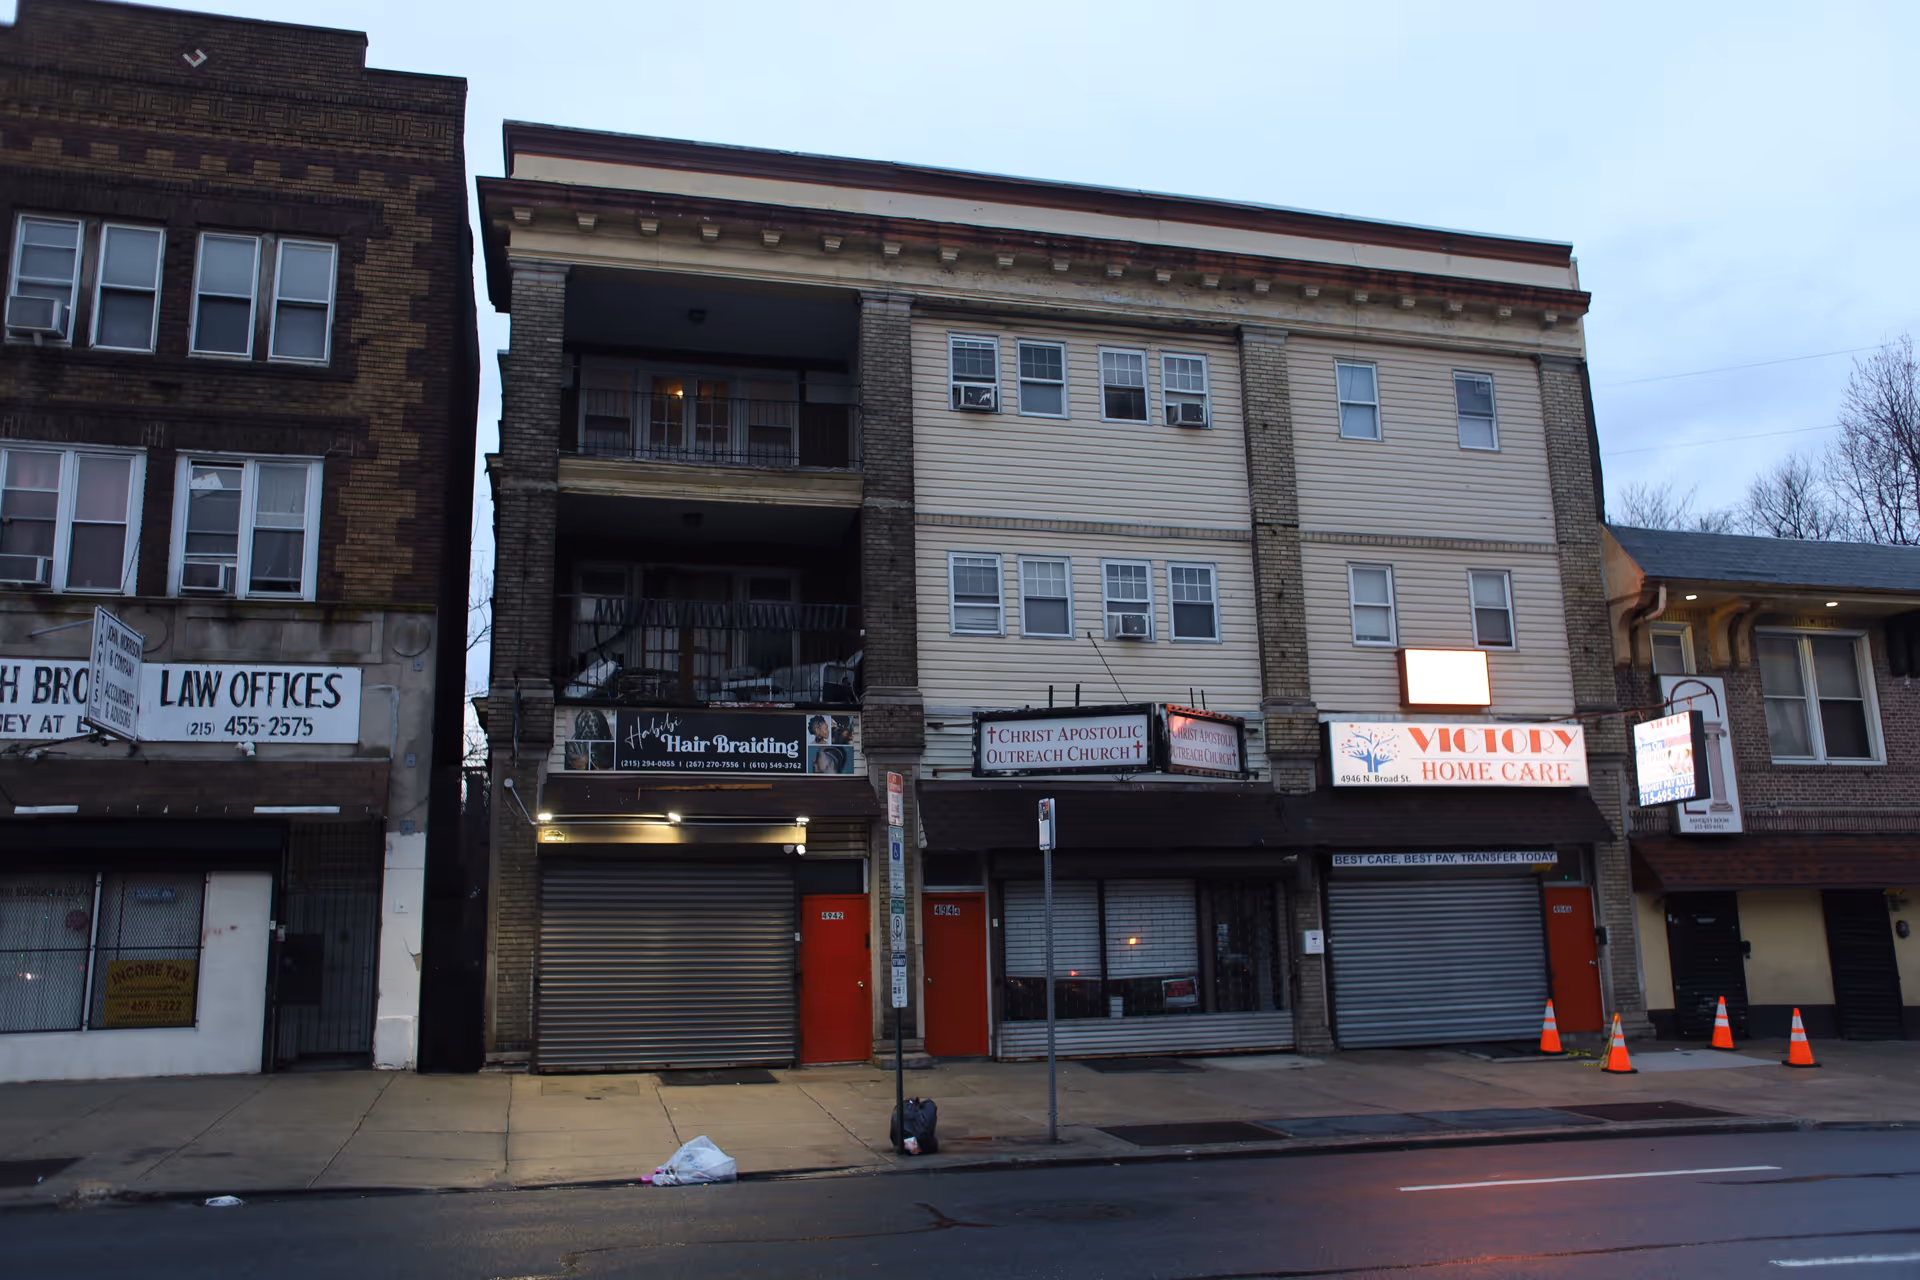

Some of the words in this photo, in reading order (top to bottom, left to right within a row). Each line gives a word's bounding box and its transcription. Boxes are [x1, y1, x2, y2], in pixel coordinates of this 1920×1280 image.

[94, 615, 106, 703] TAXES
[114, 653, 136, 679] COMPANY
[104, 680, 135, 711] ACCOUNTANTS
[160, 669, 223, 708] LAW
[229, 671, 343, 709] OFFICES
[39, 714, 66, 733] AT
[110, 703, 132, 730] ADVISORS
[186, 722, 216, 736] (215)
[224, 715, 314, 737] 455-2575
[625, 712, 683, 750] Habibi
[998, 728, 1053, 744] CHRIST
[1058, 725, 1143, 741] APOSTOLIC
[1199, 730, 1236, 748] APOSTOLIC
[1407, 727, 1578, 755] VICTORY
[660, 733, 711, 753] Hair
[712, 734, 799, 759] Braiding
[986, 748, 1064, 765] OUTREACH
[1067, 746, 1130, 762] CHURCH
[1204, 749, 1232, 765] CHURCH
[620, 759, 640, 768] (215)
[642, 760, 675, 768] 294-0055
[685, 761, 705, 769] (267)
[749, 762, 768, 770] (610)
[1422, 762, 1493, 782] HOME
[1501, 762, 1572, 783] CARE
[1340, 775, 1361, 783] 4946
[1363, 775, 1373, 783] N.
[1374, 775, 1399, 783] Broad
[1400, 775, 1411, 783] St.
[1640, 784, 1694, 807] 215-695-5877
[1334, 855, 1363, 865] BEST
[1367, 855, 1400, 865] CARE,
[1404, 855, 1432, 864] BEST
[1461, 853, 1517, 863] TRANSFER
[822, 912, 843, 920] 4942
[111, 963, 163, 985] INCOME
[166, 964, 189, 983] TAX
